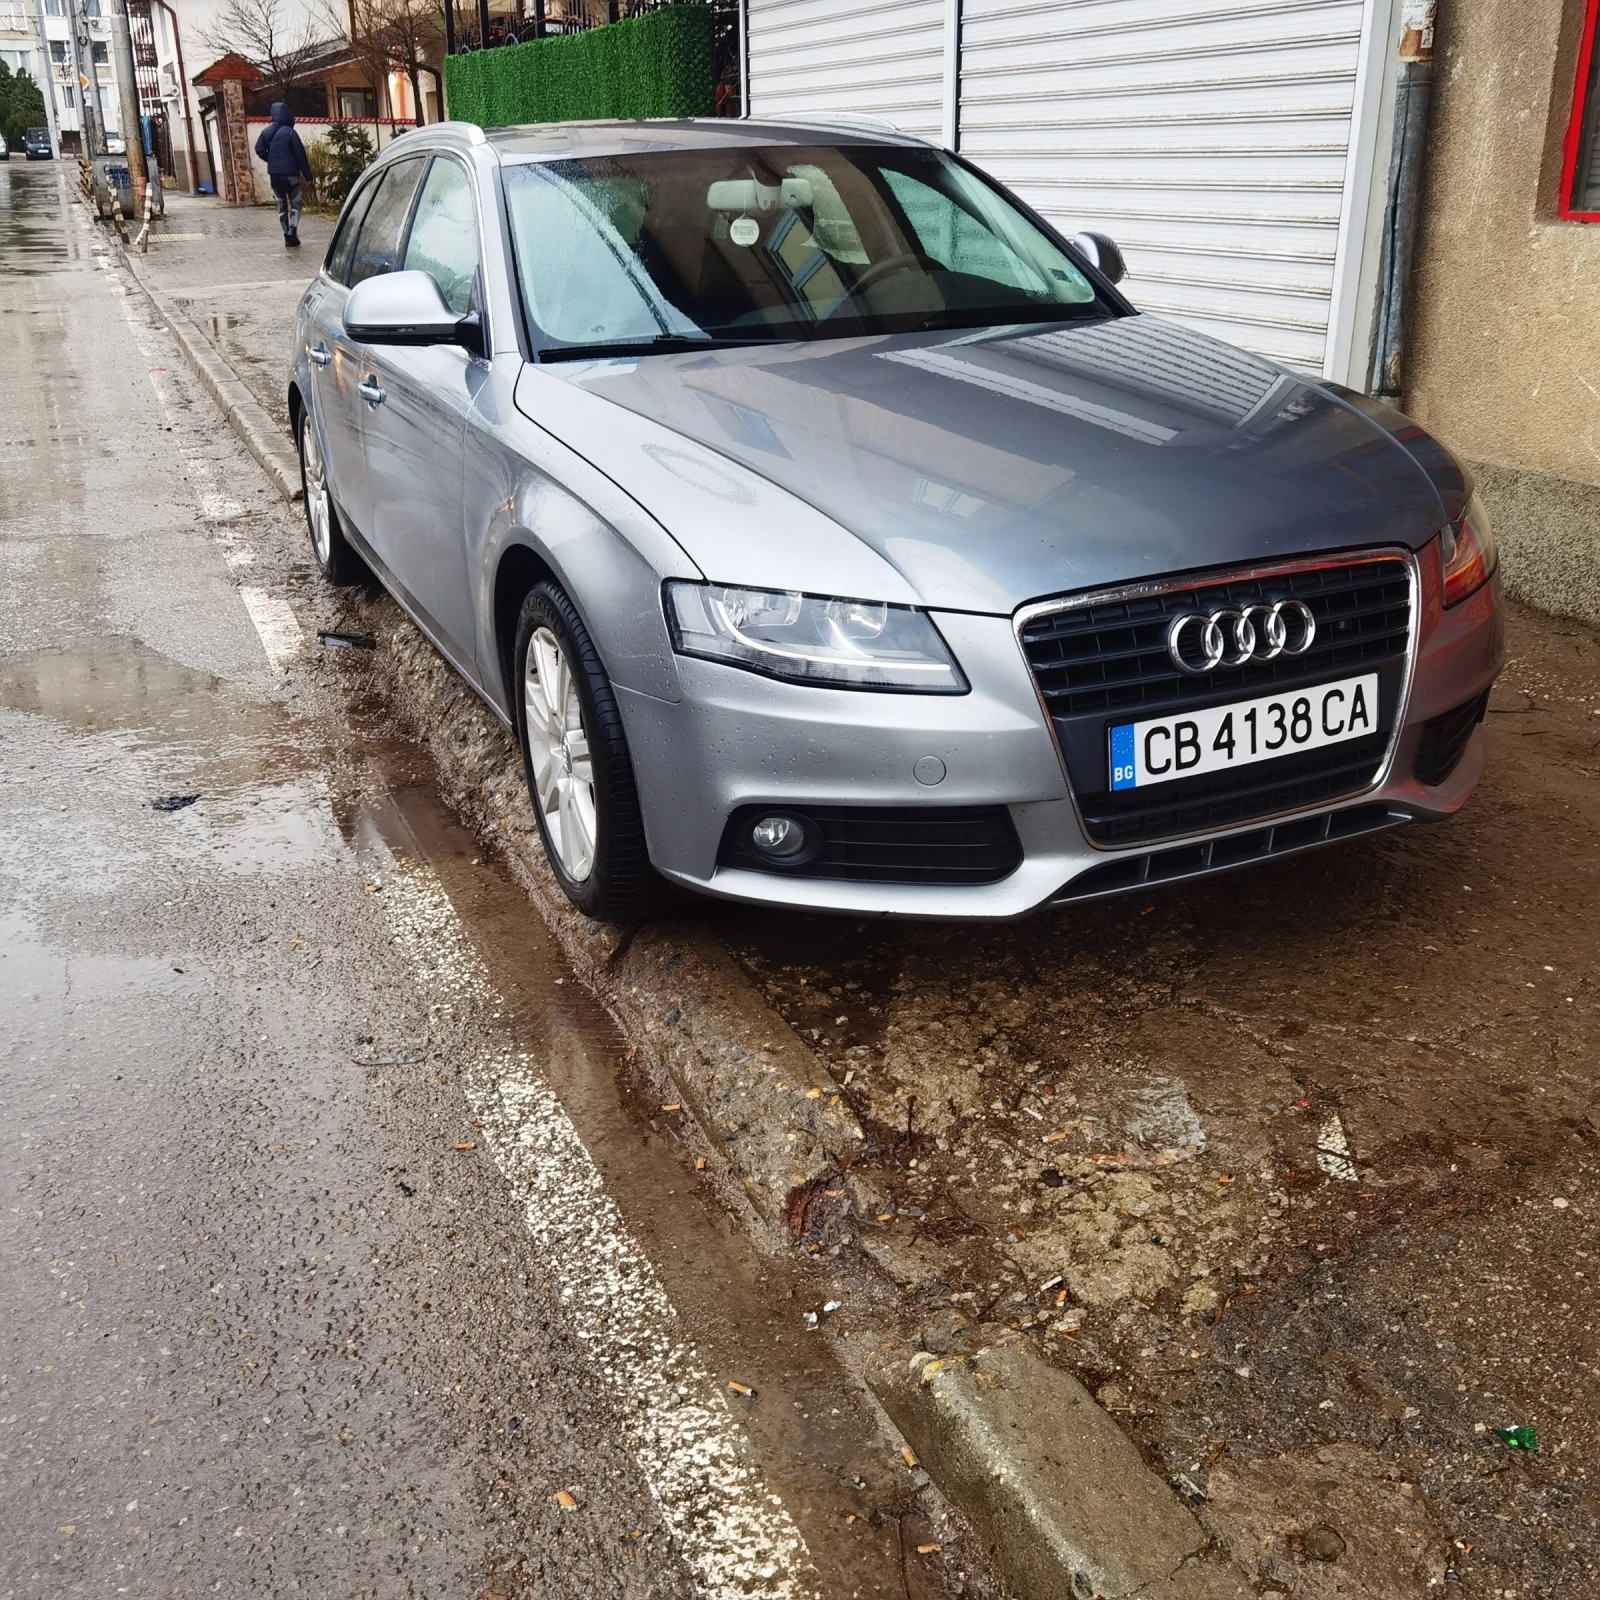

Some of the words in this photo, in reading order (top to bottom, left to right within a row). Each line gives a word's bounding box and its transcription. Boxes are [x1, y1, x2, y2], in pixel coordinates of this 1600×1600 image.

[1144, 721, 1201, 775] CB
[1213, 698, 1312, 760] 4138
[1323, 684, 1369, 736] CA
[1114, 765, 1133, 782] BG
